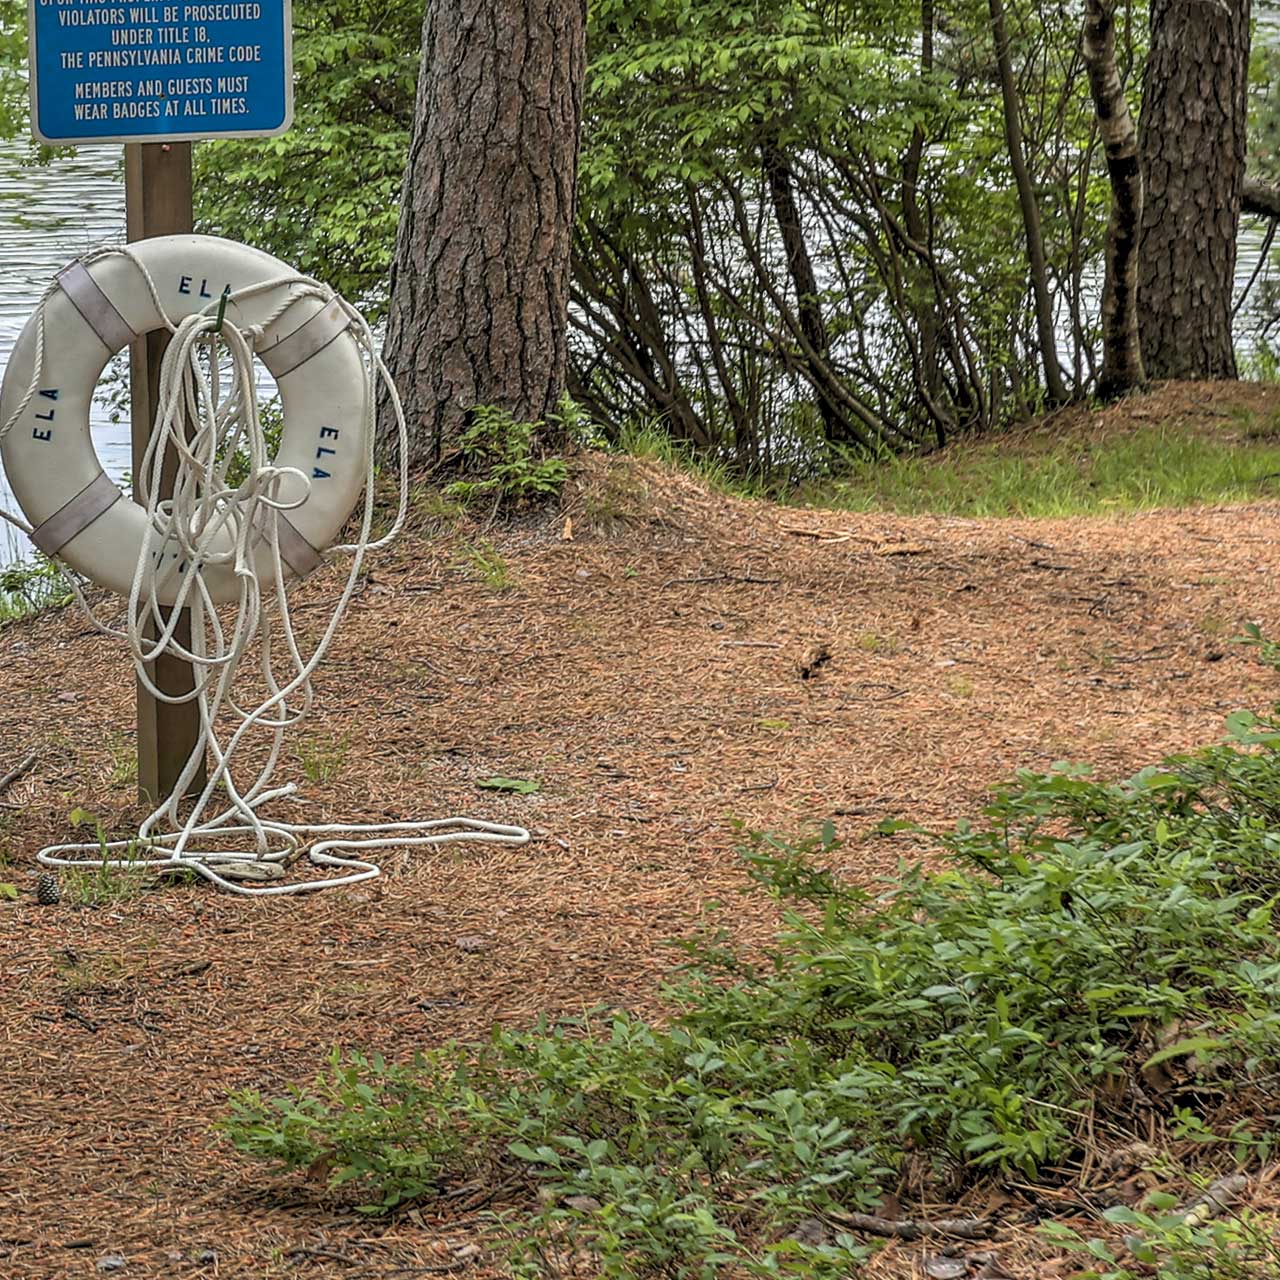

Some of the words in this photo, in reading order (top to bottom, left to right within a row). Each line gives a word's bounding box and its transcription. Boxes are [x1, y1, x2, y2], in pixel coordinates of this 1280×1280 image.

[60, 52, 83, 68] THE
[88, 48, 181, 67] PENNSYLVANIA
[186, 47, 224, 63] CRIME
[229, 45, 260, 62] CODE
[75, 80, 132, 98] MEMBERS
[137, 79, 162, 96] AND
[167, 77, 212, 95] GUESTS
[217, 76, 248, 93] MUST
[74, 103, 107, 120] WEAR
[113, 101, 160, 118] BADGES
[164, 100, 179, 116] AT
[183, 99, 206, 115] ALL
[210, 97, 249, 114] TIMES.
[32, 388, 59, 442] ELA
[311, 426, 339, 479] ELA
